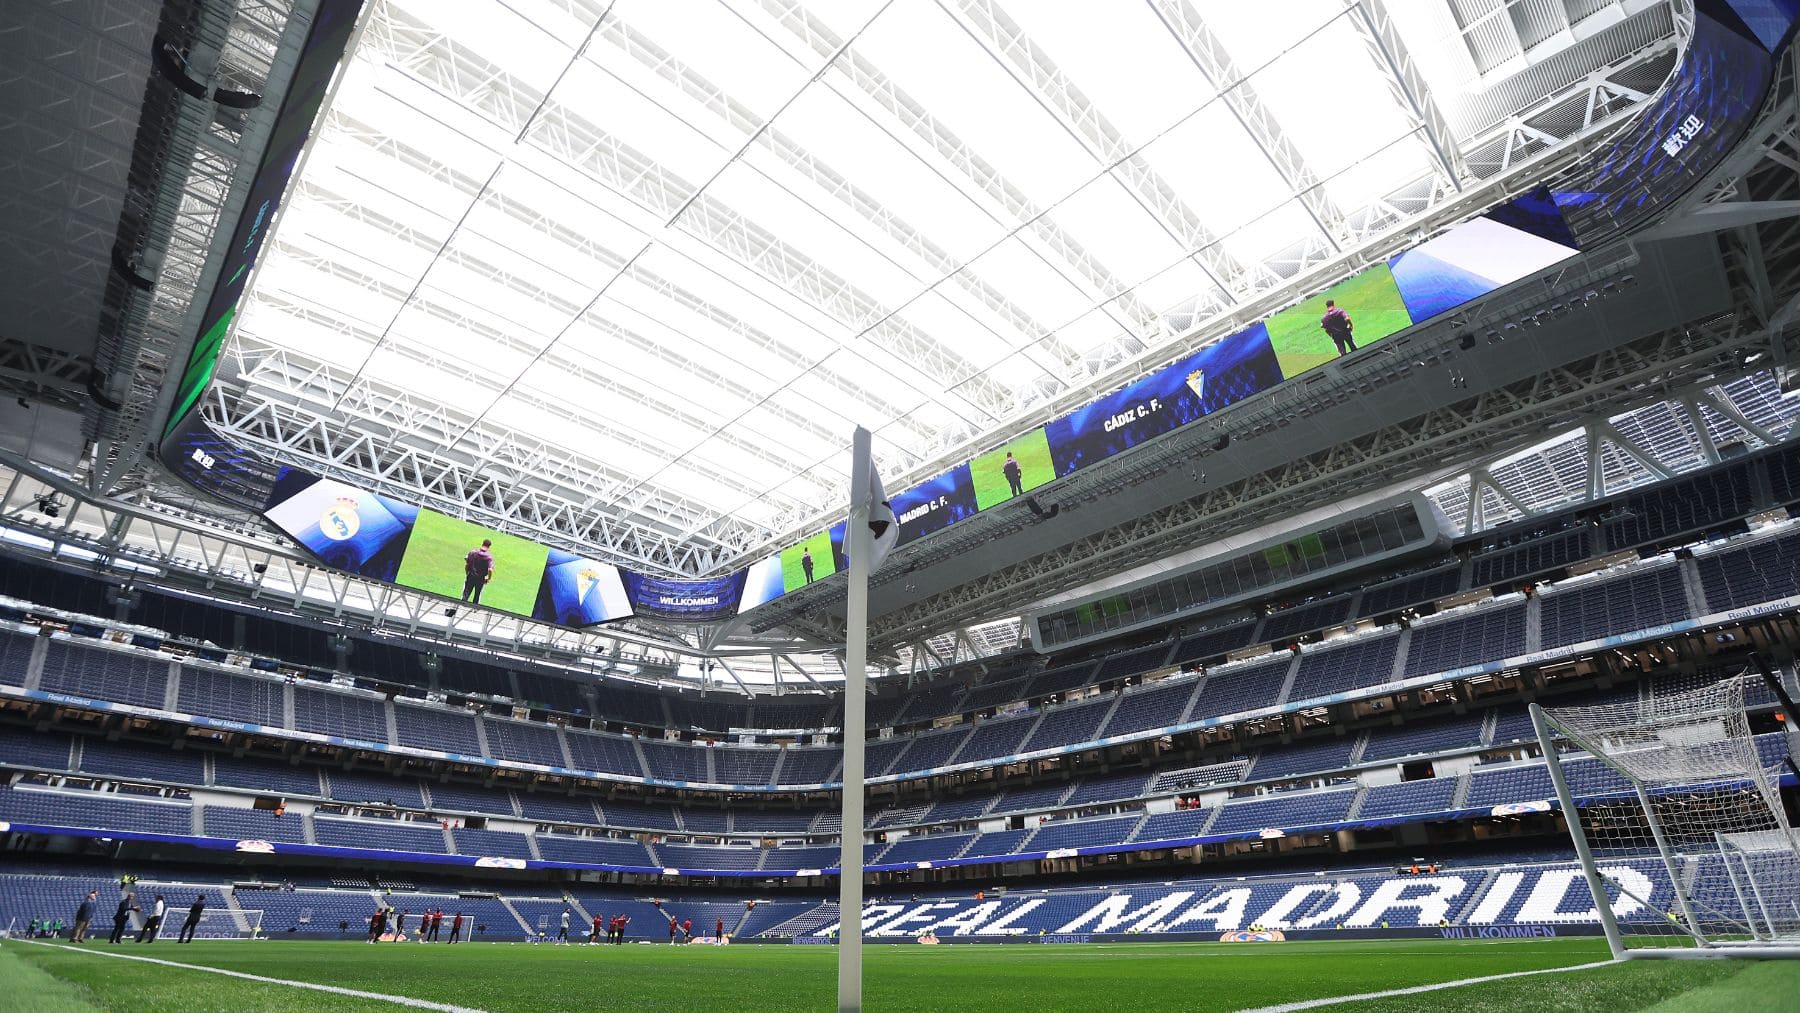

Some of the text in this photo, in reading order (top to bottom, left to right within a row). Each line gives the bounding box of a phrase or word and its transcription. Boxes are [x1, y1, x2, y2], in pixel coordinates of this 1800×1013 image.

[1104, 398, 1162, 432] CÁDIZ C. F.
[899, 495, 948, 525] MADRID C. F.
[659, 596, 719, 606] WILLKOMMEN
[1727, 600, 1791, 621] Real Madrid
[1620, 625, 1673, 644] Real Madrid
[1526, 646, 1575, 664] Real Madrid
[1442, 665, 1484, 680] Real Madrid
[1365, 681, 1405, 696] Real Madrid
[813, 866, 1653, 936] REAL MADRID
[1040, 935, 1090, 944] BIENVENUE
[1440, 926, 1557, 939] WILLKOMMEN
